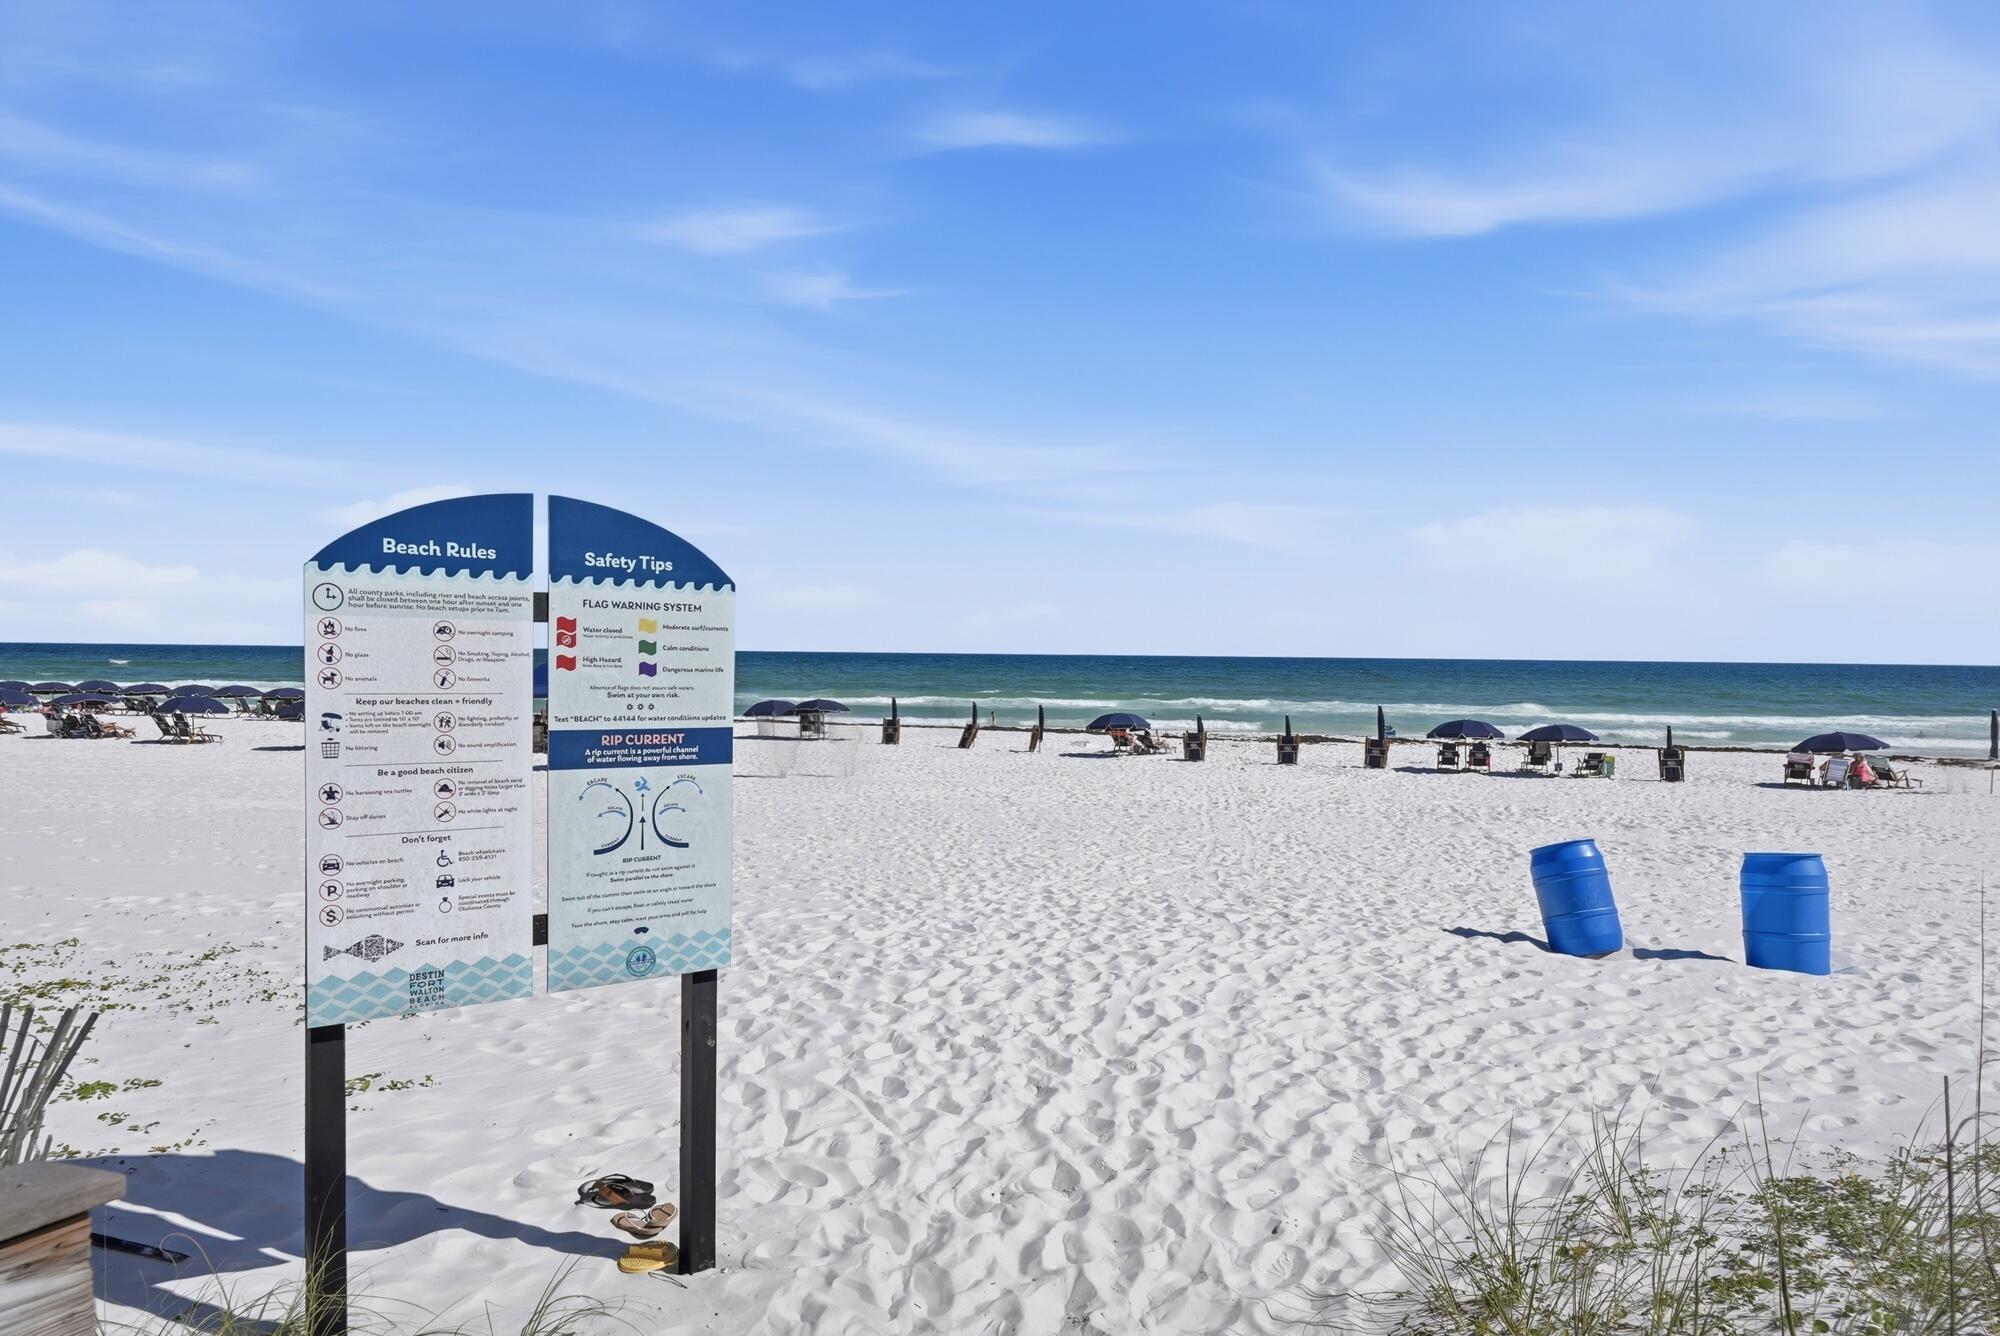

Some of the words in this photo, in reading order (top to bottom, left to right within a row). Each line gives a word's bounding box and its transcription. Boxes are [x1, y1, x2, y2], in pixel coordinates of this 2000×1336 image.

[382, 538, 441, 556] Beach
[446, 542, 496, 559] Rules
[584, 552, 636, 573] Safety
[639, 555, 673, 574] Tips
[406, 590, 436, 599] including
[583, 600, 609, 609] FLAG
[611, 601, 661, 611] WARNING
[664, 603, 702, 612] SYSTEM
[583, 656, 598, 664] High
[662, 666, 693, 674] Dangerous
[356, 698, 378, 706] Keep
[462, 698, 493, 706] friendly
[601, 735, 623, 746] RIP
[625, 733, 685, 746] CURRENT
[584, 748, 591, 756] A
[643, 746, 671, 755] powerful
[673, 745, 699, 753] channel
[617, 755, 642, 763] flowing
[398, 768, 418, 778] good
[420, 767, 444, 775] beach
[446, 766, 473, 774] citizen
[587, 777, 608, 786] ESCAPE
[402, 835, 424, 844] Don't
[427, 835, 451, 844] forget
[415, 938, 436, 947] Scan
[438, 936, 449, 945] for
[473, 932, 489, 940] info
[409, 970, 445, 982] DESTIN
[409, 979, 444, 989] FORT
[410, 987, 445, 997] WALTON
[409, 994, 445, 1004] BEACH
